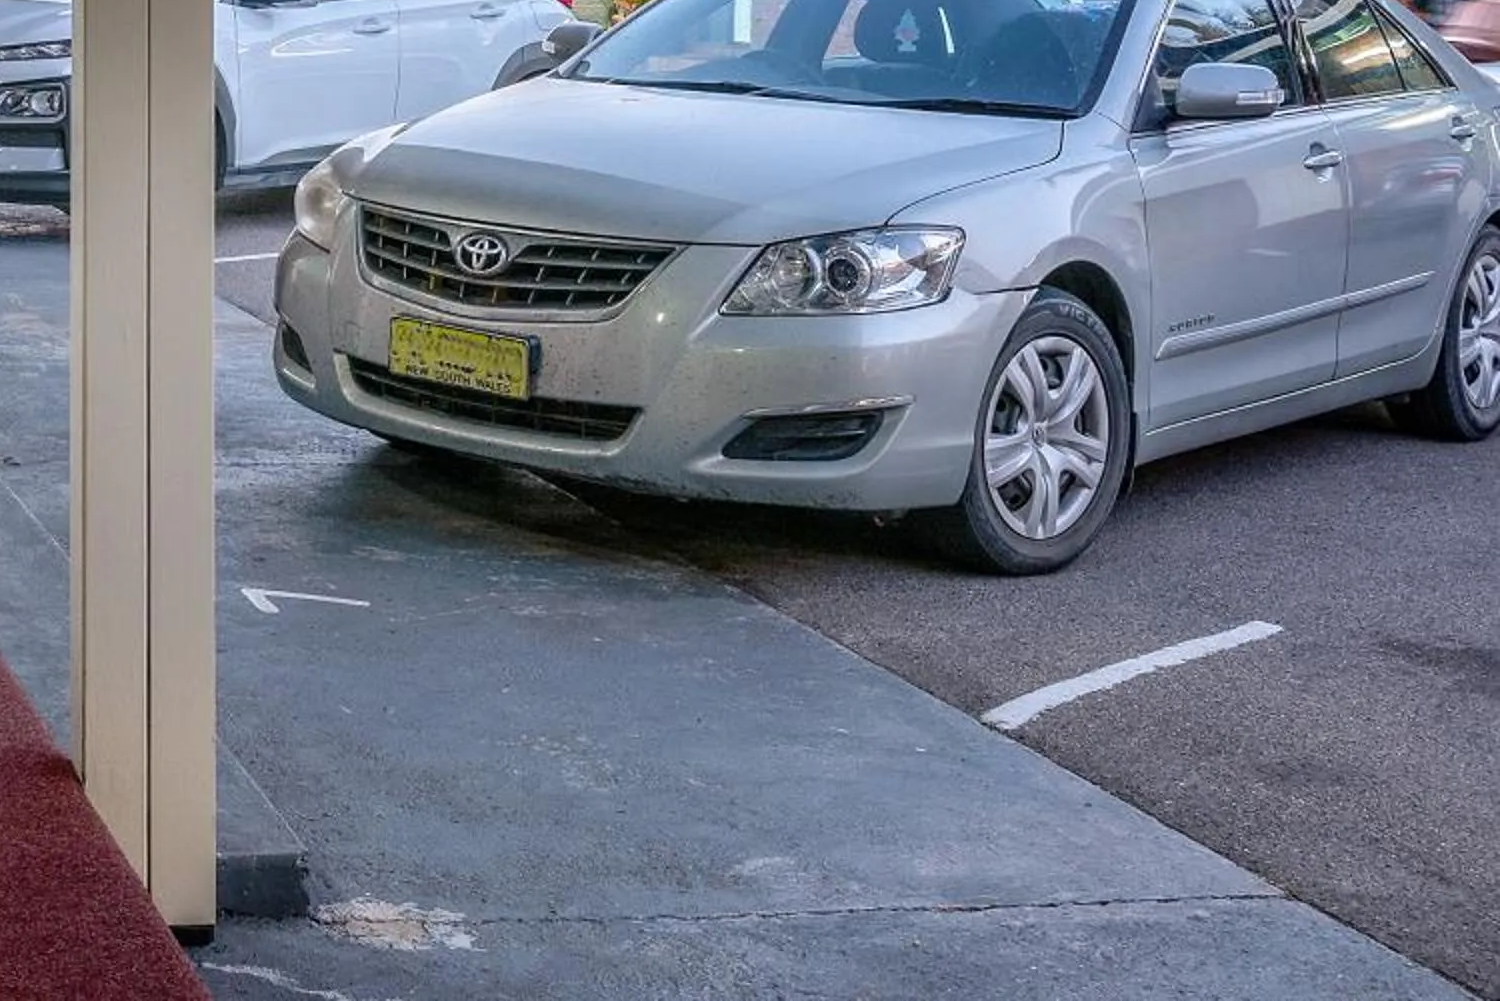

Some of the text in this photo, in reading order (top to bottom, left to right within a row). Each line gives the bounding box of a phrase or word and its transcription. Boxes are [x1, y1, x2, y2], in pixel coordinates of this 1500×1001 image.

[405, 364, 513, 395] NEW SOUTH WALES
